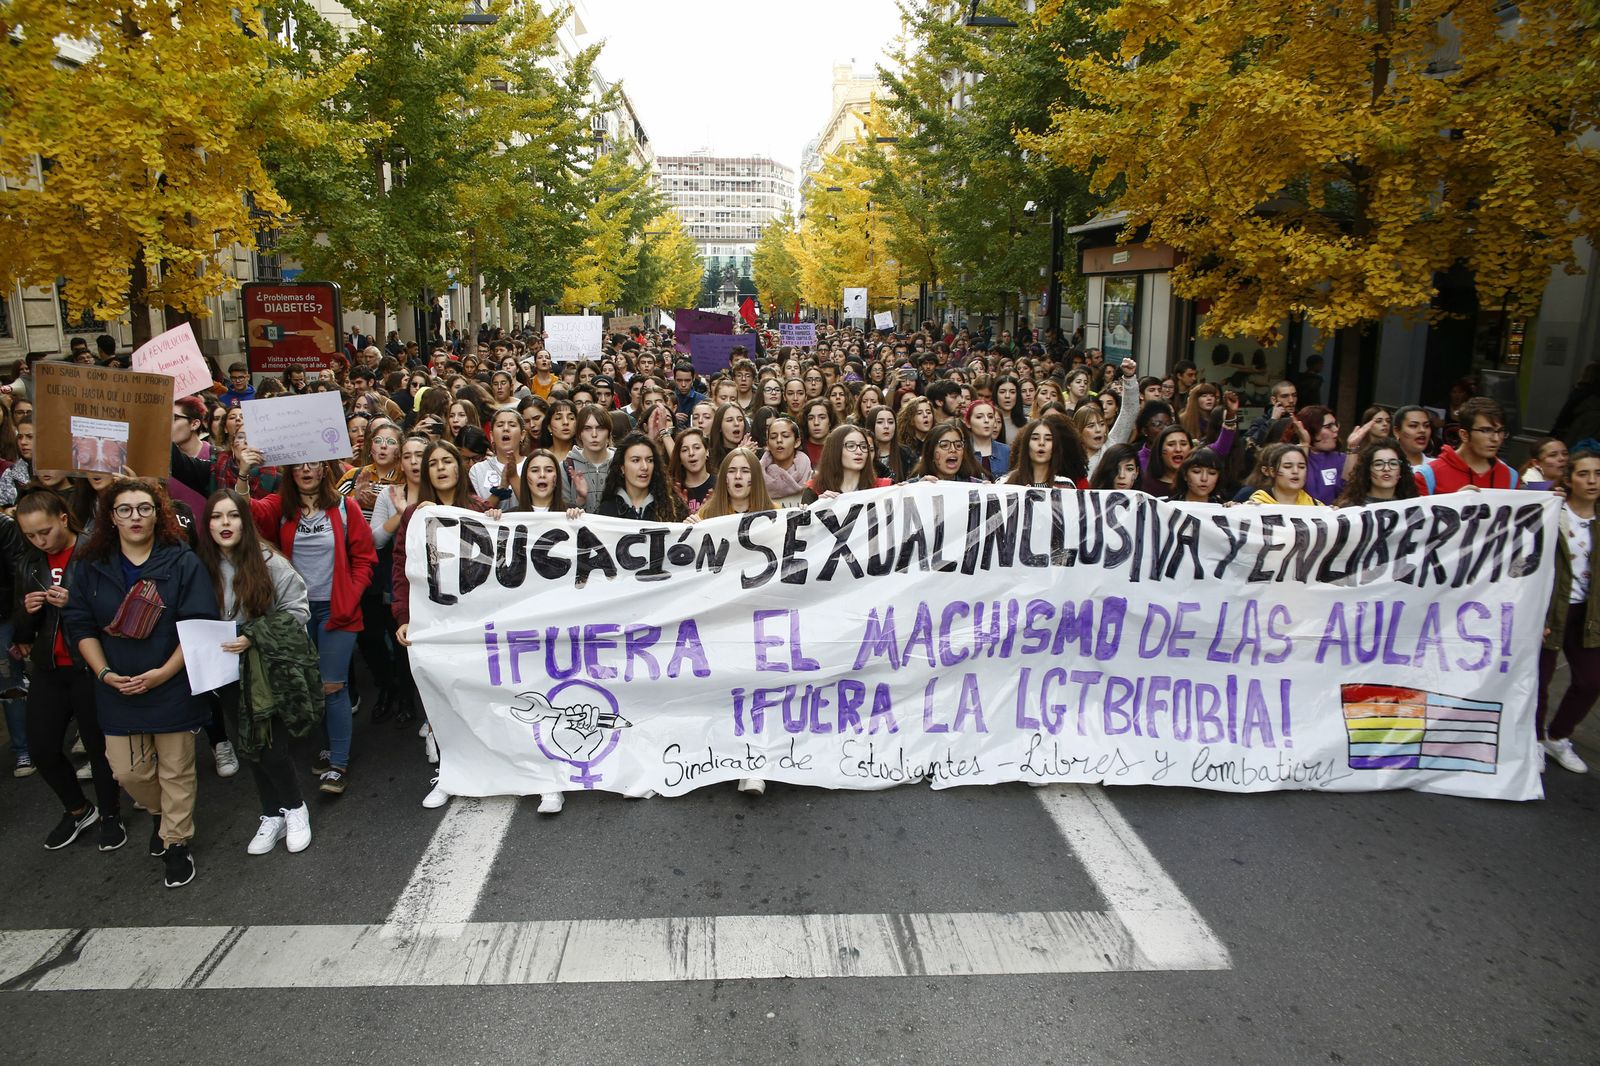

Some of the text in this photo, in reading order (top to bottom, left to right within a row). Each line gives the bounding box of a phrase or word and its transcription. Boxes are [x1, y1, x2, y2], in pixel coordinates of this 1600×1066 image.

[256, 291, 316, 301] ¿Problemas de
[264, 303, 323, 314] DIABETES?
[137, 352, 147, 367] LA
[41, 366, 55, 376] NO
[112, 374, 129, 384] ERA
[131, 375, 142, 384] MI
[144, 375, 170, 386] PROPIO
[46, 384, 78, 398] CUERPO
[81, 387, 105, 400] HASTA
[122, 391, 132, 404] LO
[74, 402, 88, 415] POR
[101, 405, 127, 419] MISMA
[424, 487, 1545, 605] EDUCACIÓN SEXUAL INCLUSIVA Y EN LIBERTAD
[485, 595, 1515, 687] ¡FUERA EL MACHISMO DE LAS AULAS!
[731, 666, 1293, 749] ¡FUERA LA LGTBIFOBIA!
[662, 743, 767, 788] Sindicato
[779, 737, 813, 771] de
[838, 739, 985, 783] Estudiantes
[1019, 732, 1144, 777] Libres
[1153, 749, 1177, 781] y
